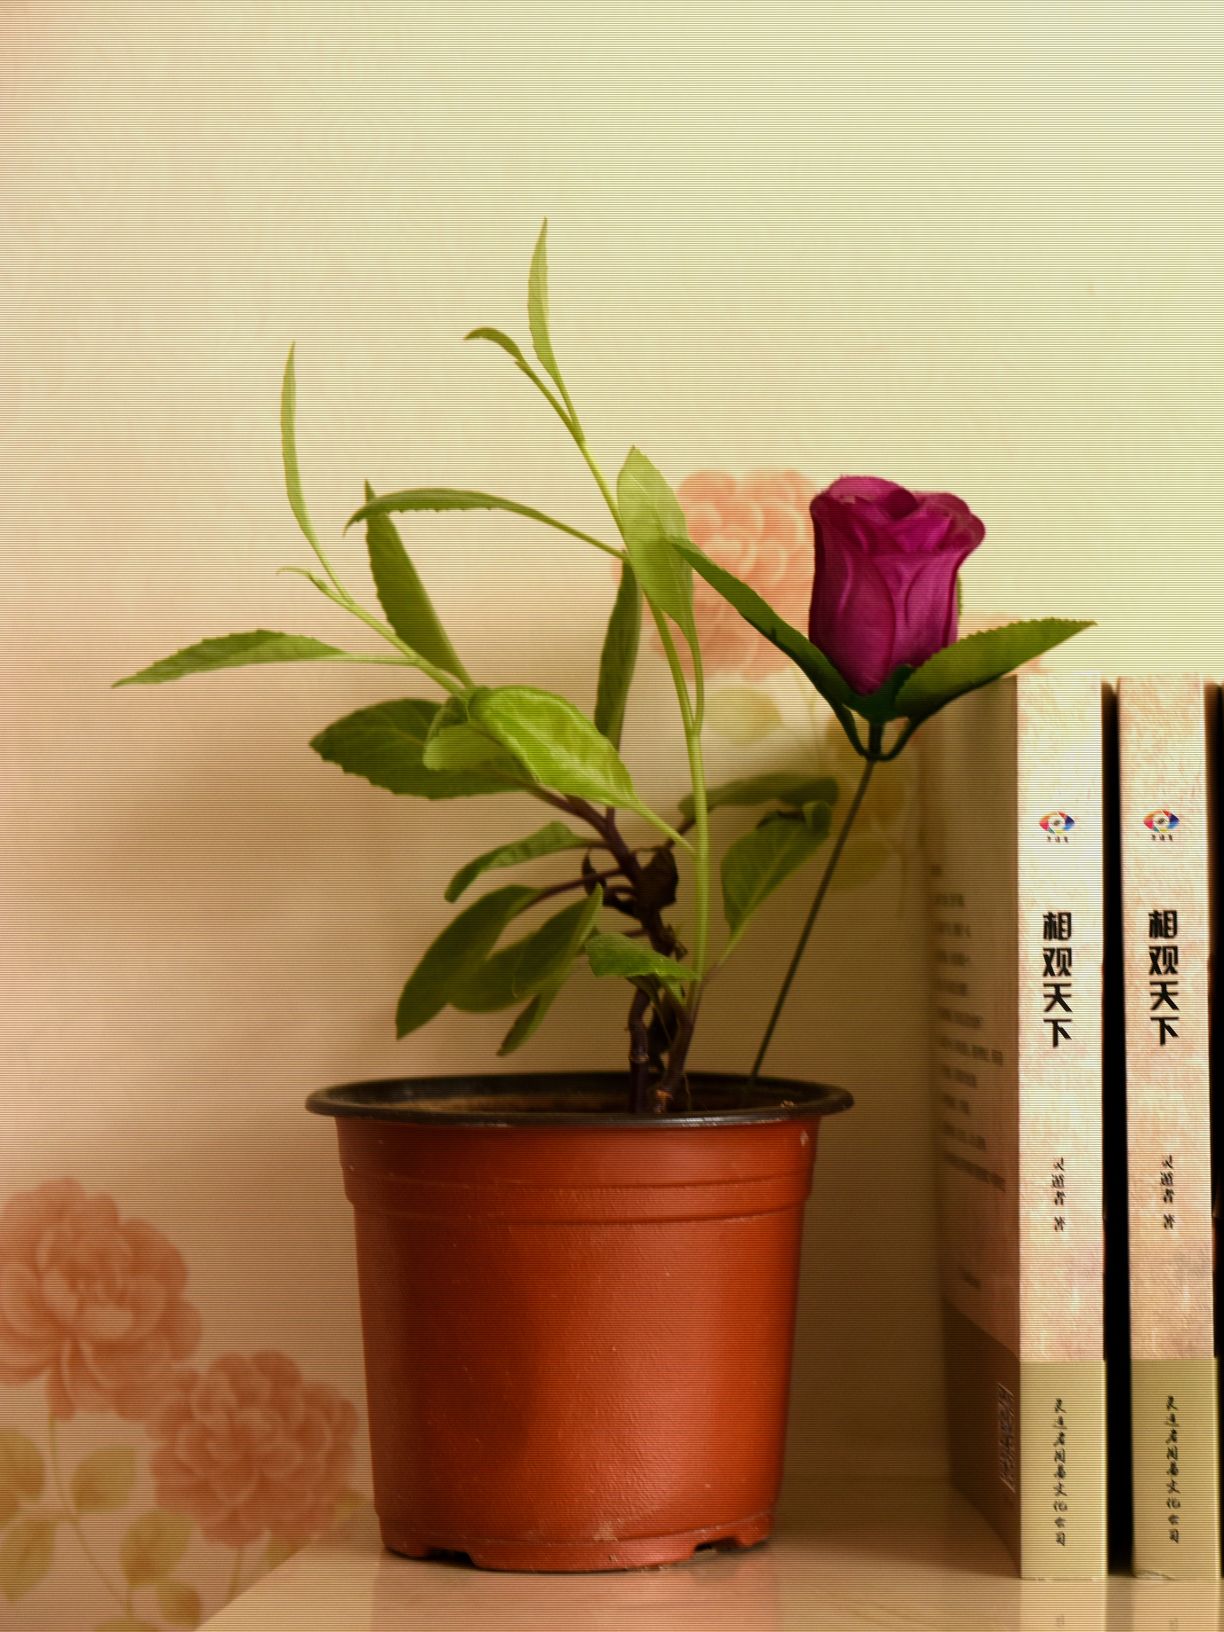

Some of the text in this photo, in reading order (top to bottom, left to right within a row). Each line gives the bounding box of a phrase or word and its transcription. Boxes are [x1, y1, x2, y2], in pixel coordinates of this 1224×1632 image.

[1043, 911, 1074, 1051] 相观天下
[1148, 909, 1181, 1050] 相观天下
